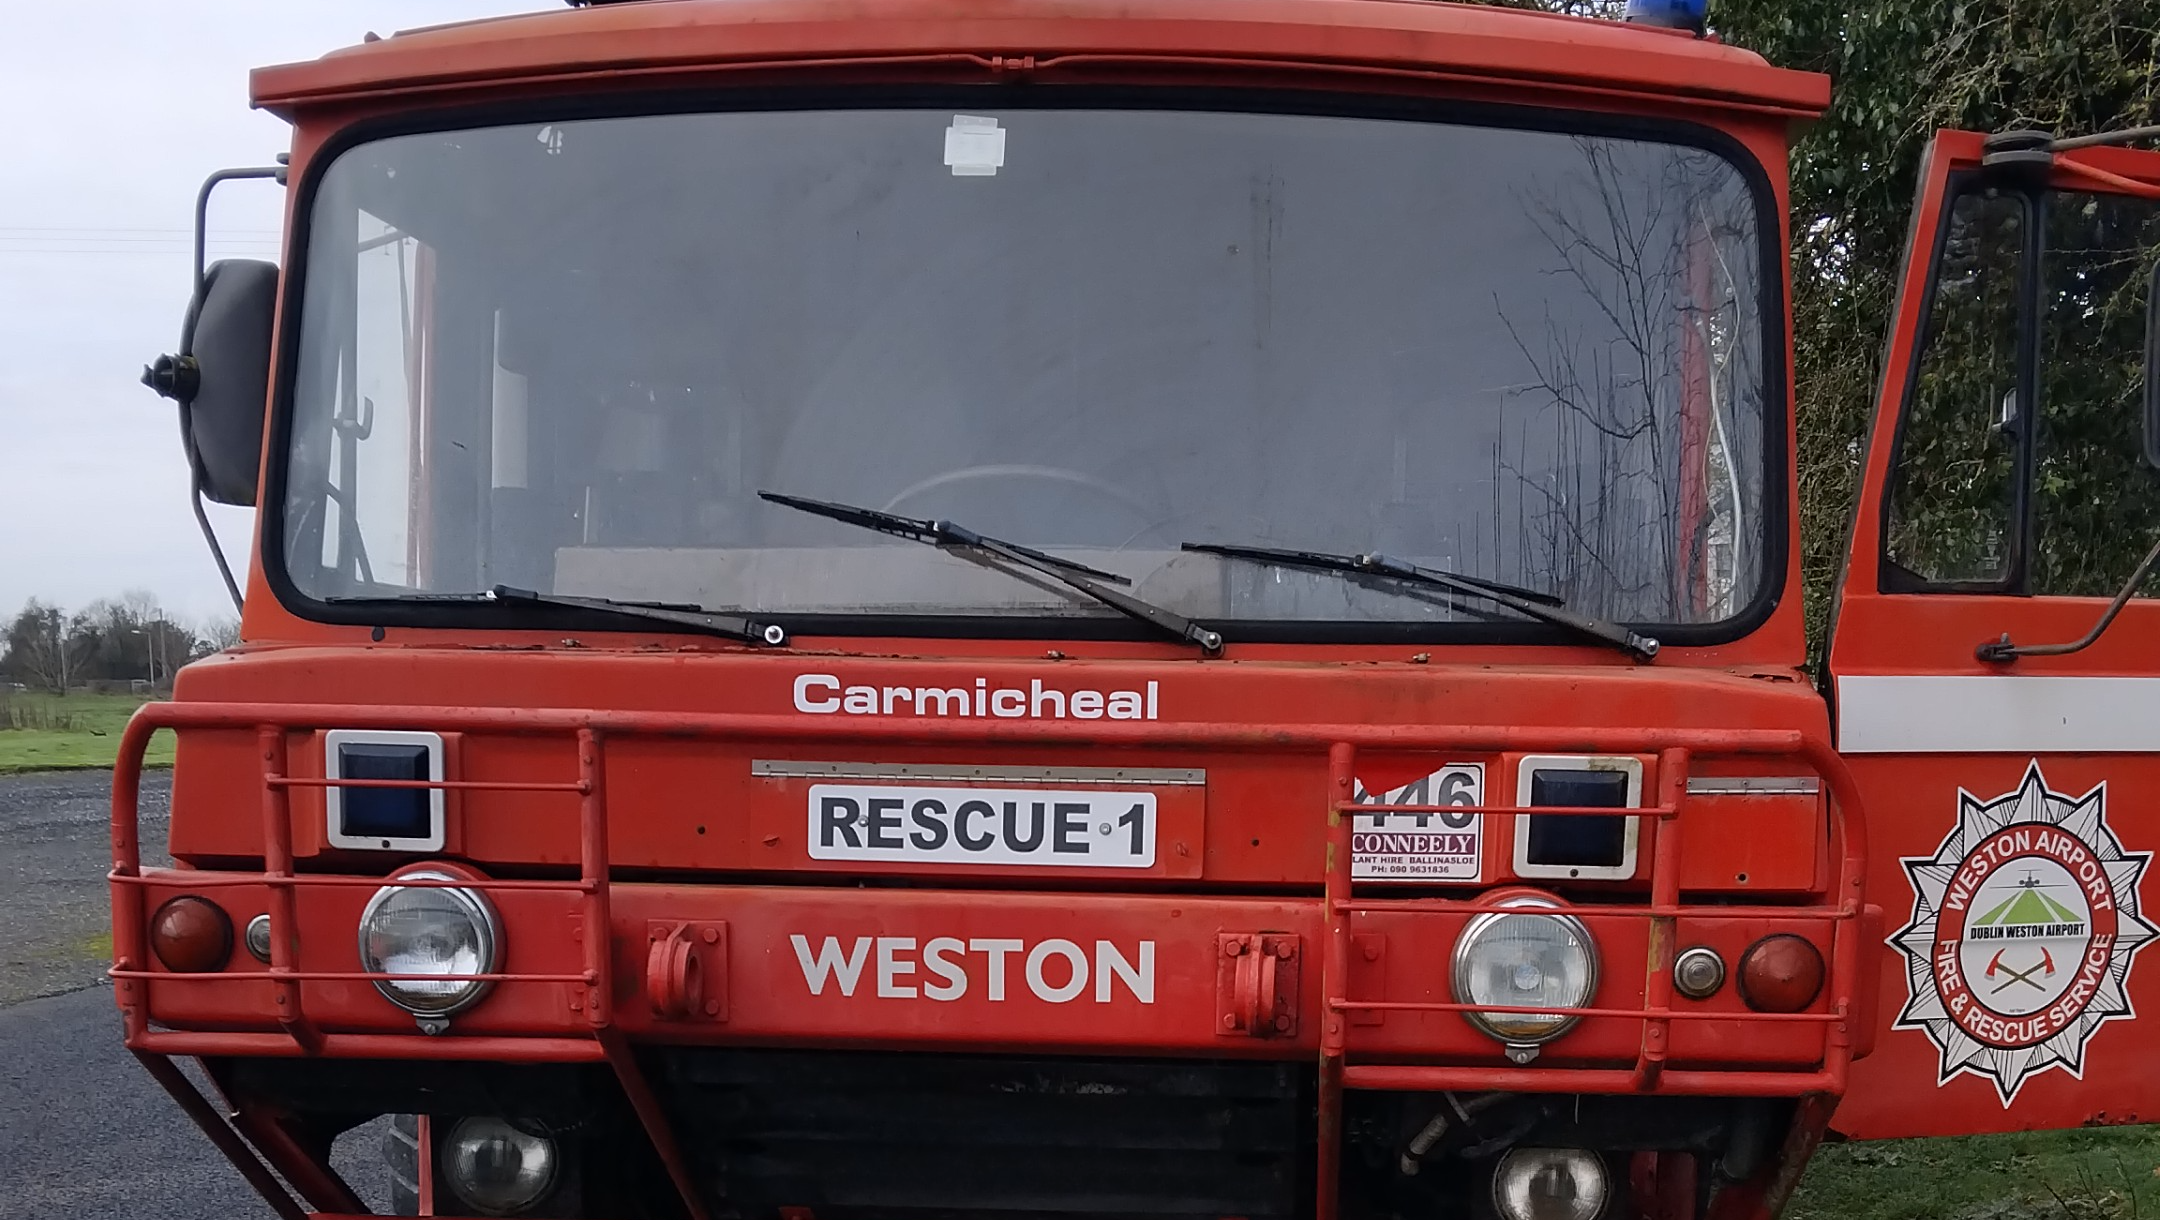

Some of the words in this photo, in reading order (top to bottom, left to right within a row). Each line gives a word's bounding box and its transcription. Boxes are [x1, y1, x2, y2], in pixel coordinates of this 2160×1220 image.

[793, 674, 1159, 720] Carmicheal
[820, 797, 1091, 854] RESCUE
[1117, 803, 1145, 855] 1
[1352, 834, 1472, 853] CONNEELY
[1380, 856, 1403, 864] HIRE
[1409, 857, 1475, 865] BALLINASLOE
[1409, 866, 1449, 874] 9631836
[1946, 830, 2030, 911] WESTON
[2034, 830, 2112, 911] AIRPORT
[1970, 927, 2003, 940] DUBLIN
[2006, 925, 2044, 939] WESTON
[2046, 923, 2085, 936] AIRPORT
[790, 934, 1155, 1004] WESTON
[1938, 939, 1961, 995] FIRE
[1950, 993, 1968, 1015] &
[1963, 1005, 2048, 1043] RESCUE
[2049, 933, 2113, 1027] SERVICE
